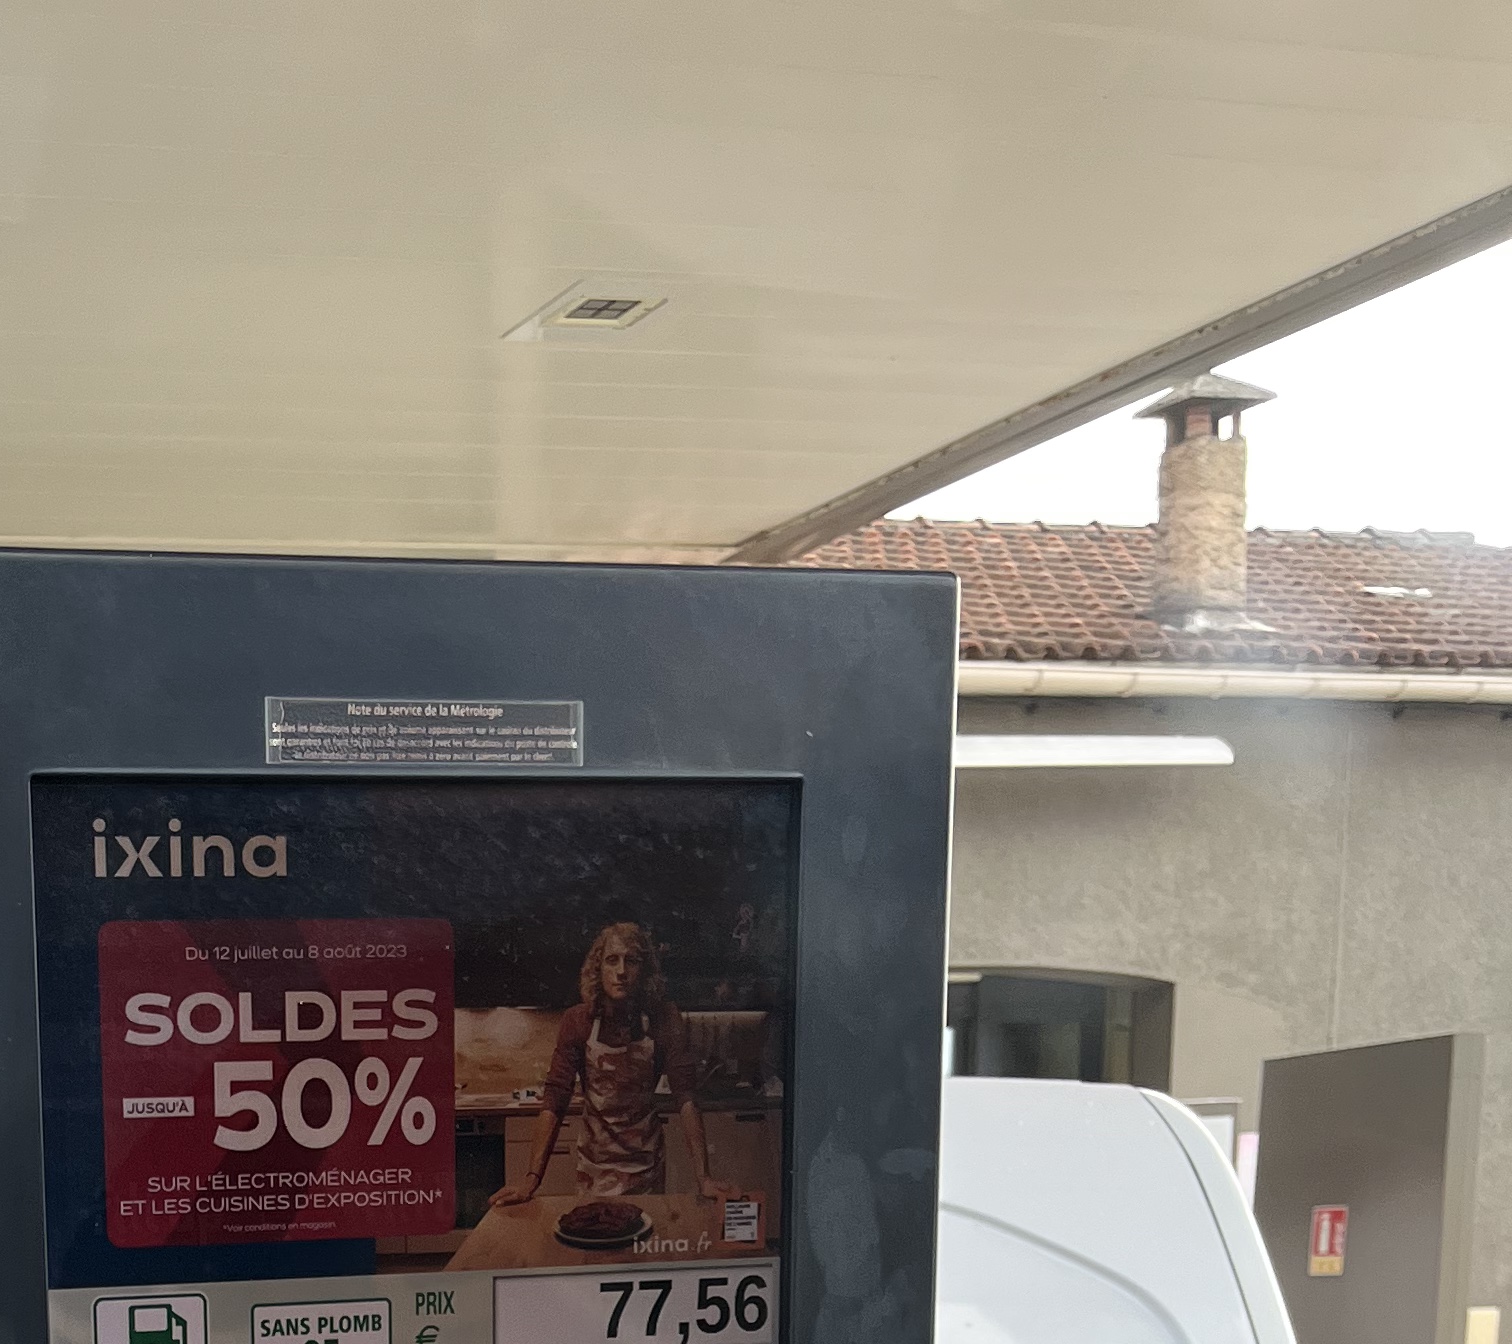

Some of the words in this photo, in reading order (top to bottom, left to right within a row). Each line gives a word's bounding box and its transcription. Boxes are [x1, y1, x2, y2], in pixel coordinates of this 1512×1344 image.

[348, 704, 372, 716] Note
[374, 704, 388, 716] du
[390, 704, 422, 717] service
[424, 704, 436, 716] de
[438, 704, 448, 716] la
[450, 704, 504, 719] Métrologie
[92, 817, 288, 878] ixina
[185, 946, 208, 962] Du
[211, 946, 230, 961] 12
[233, 944, 279, 963] juillet
[282, 948, 304, 959] au
[308, 946, 319, 959] 8
[323, 944, 362, 959] août
[366, 945, 407, 958] 2023
[123, 987, 439, 1046] SOLDES
[127, 1099, 190, 1115] JUSQU'À
[213, 1056, 436, 1151] 50%
[147, 1175, 191, 1193] SUR
[195, 1168, 412, 1192] L'ÉLECTROMÉNAGER
[120, 1200, 146, 1216] ET
[152, 1199, 192, 1215] LES
[196, 1194, 291, 1213] CUISINES
[416, 1291, 456, 1316] PRIX
[598, 1275, 770, 1344] 77,56
[260, 1316, 310, 1338] SANS
[316, 1312, 383, 1334] PLOMB
